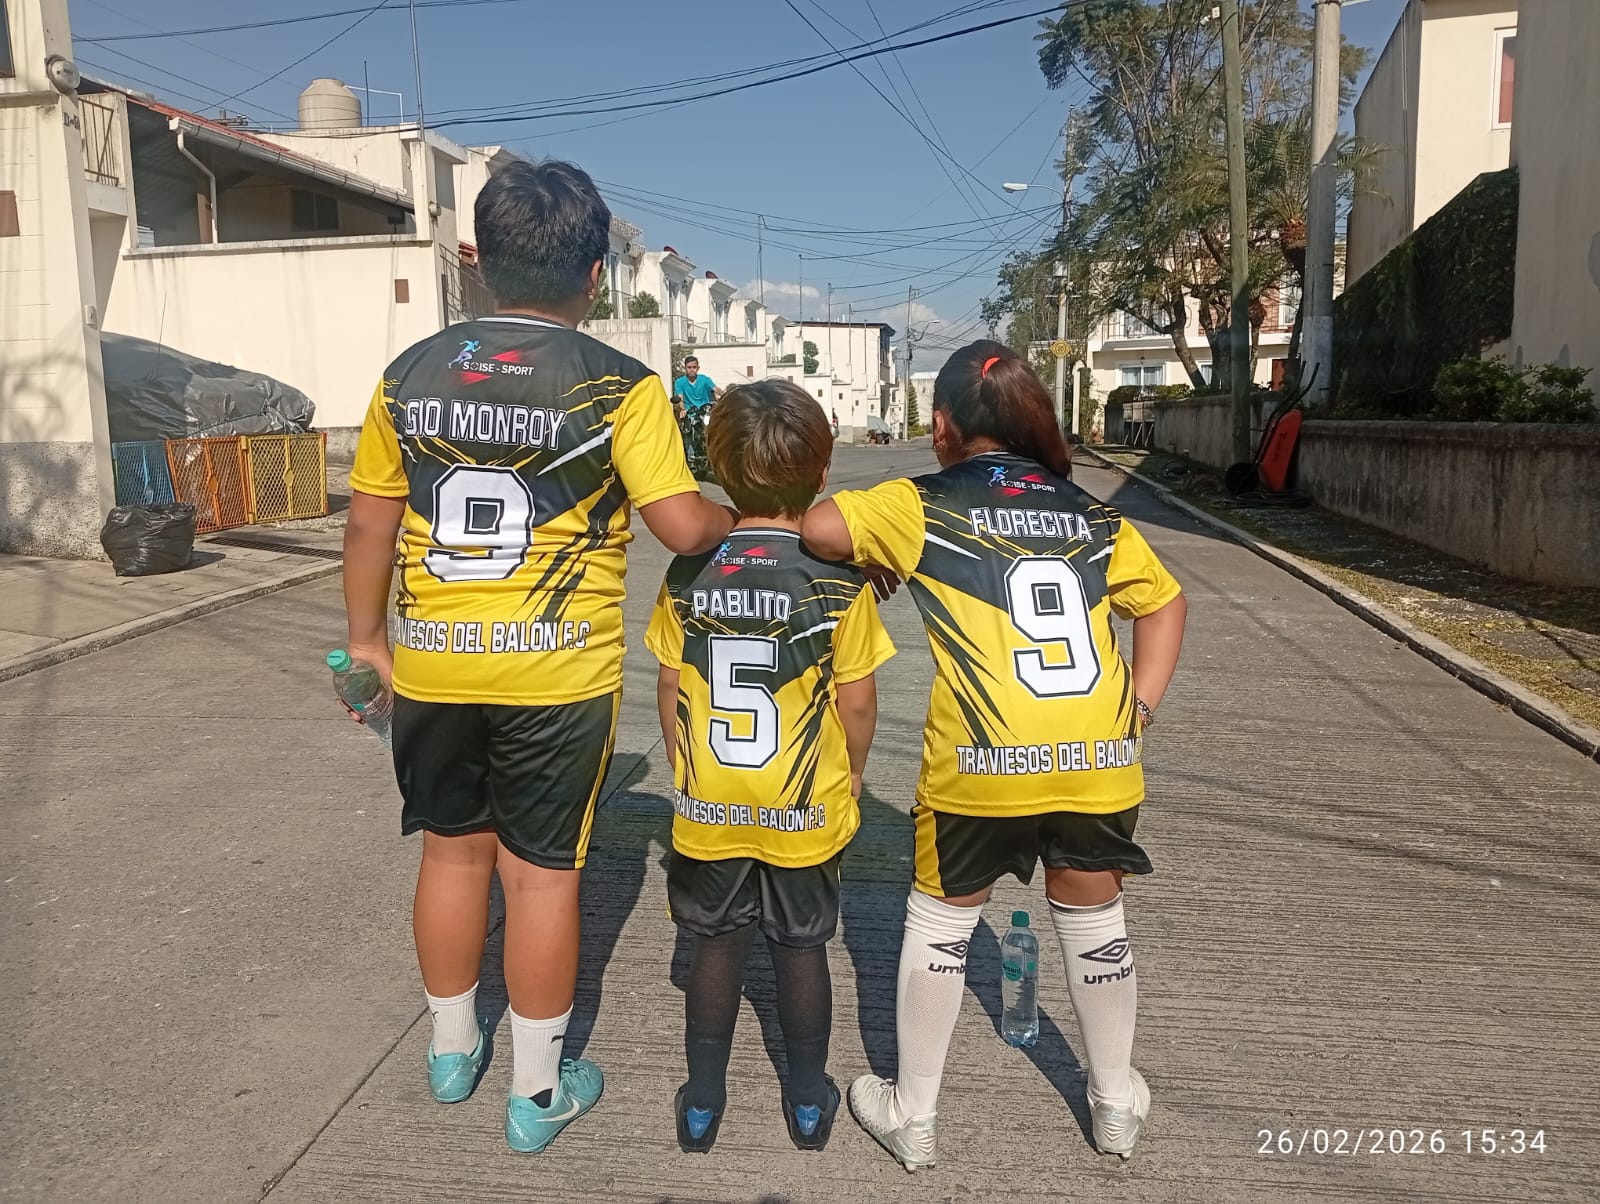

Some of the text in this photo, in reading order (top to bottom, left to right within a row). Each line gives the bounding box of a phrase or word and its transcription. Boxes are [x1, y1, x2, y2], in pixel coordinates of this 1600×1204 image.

[404, 398, 567, 450] GIO MONROY
[422, 463, 535, 582] 9
[968, 507, 1094, 542] FLORECITA
[691, 588, 792, 623] PABLITO
[451, 621, 486, 653] DEL
[491, 615, 558, 653] BALÓN
[1003, 555, 1103, 698] 9
[707, 634, 780, 769] 5
[956, 743, 1053, 775] TRAVIESOS
[1057, 741, 1091, 772] DEL
[729, 804, 756, 826] DEL
[758, 804, 805, 832] BALÓN
